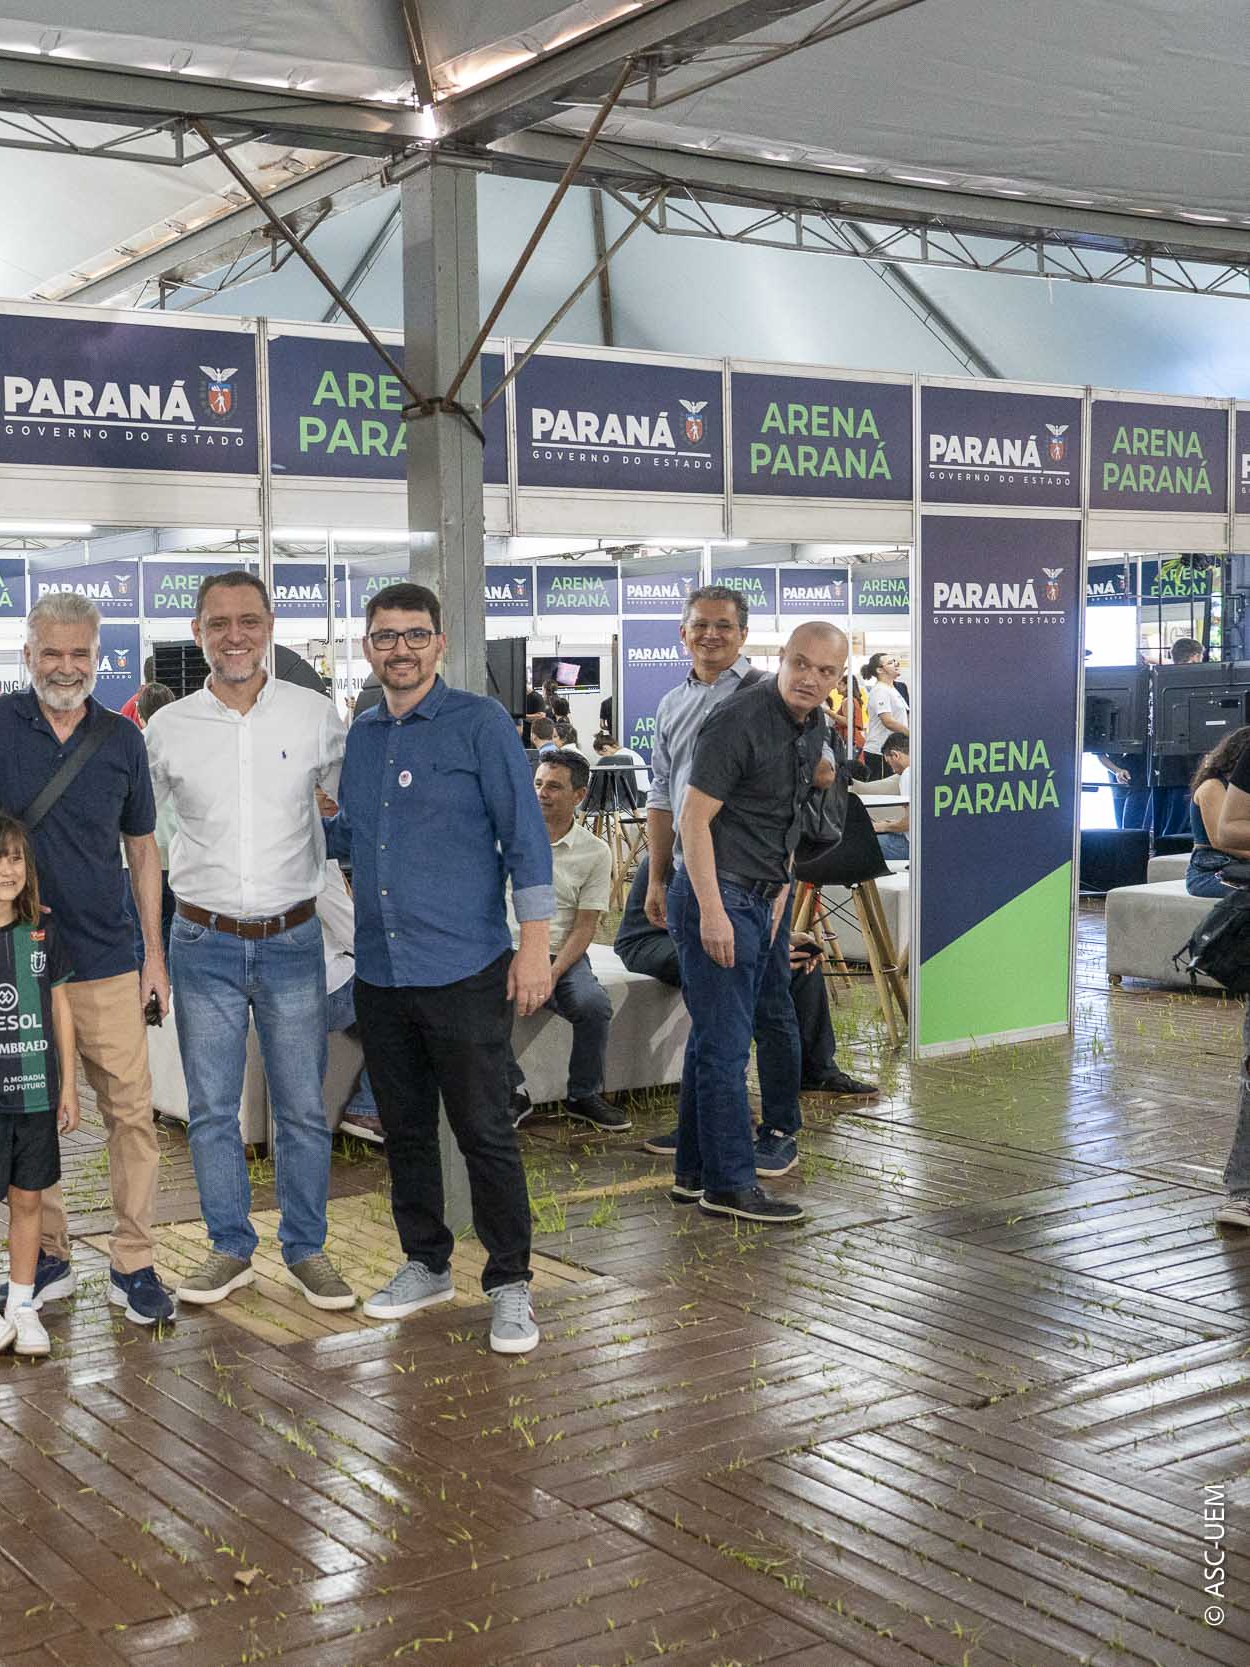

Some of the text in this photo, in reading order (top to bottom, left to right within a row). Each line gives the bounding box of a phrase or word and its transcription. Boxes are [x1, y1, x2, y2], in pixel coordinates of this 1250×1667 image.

[4, 376, 196, 423] PARANÁ
[312, 370, 403, 411] ARE
[532, 408, 676, 449] PARANÁ
[761, 402, 880, 440] ARENA
[5, 424, 244, 447] GOVERNO DO ESTADO
[299, 416, 407, 457] PARA
[1112, 426, 1204, 460] ARENA
[533, 451, 712, 470] GOVERNO DO ESTADO
[929, 434, 1042, 468] PARANÁ
[750, 441, 893, 481] PARANÁ
[929, 471, 1071, 486] GOVERNO DO ESTADO
[1102, 460, 1212, 495] PARANÁ
[160, 575, 200, 590] ARE
[273, 583, 323, 600] RANÁ
[551, 577, 605, 591] ARENA
[626, 582, 681, 598] PARANÁ
[862, 579, 906, 592] ARENA
[546, 592, 611, 608] PARANÁ
[783, 585, 832, 600] PARANÁ
[858, 593, 910, 607] PARANÁ
[933, 578, 1039, 609] PARANÁ
[933, 616, 1065, 625] GOVERNO DO ESTADO
[628, 645, 679, 660] PARANÁ
[944, 739, 1051, 776] ARENA
[934, 770, 1060, 817] PARANÁ
[3, 1081, 46, 1092] DO FUTURO
[10, 1073, 46, 1084] MORADIA
